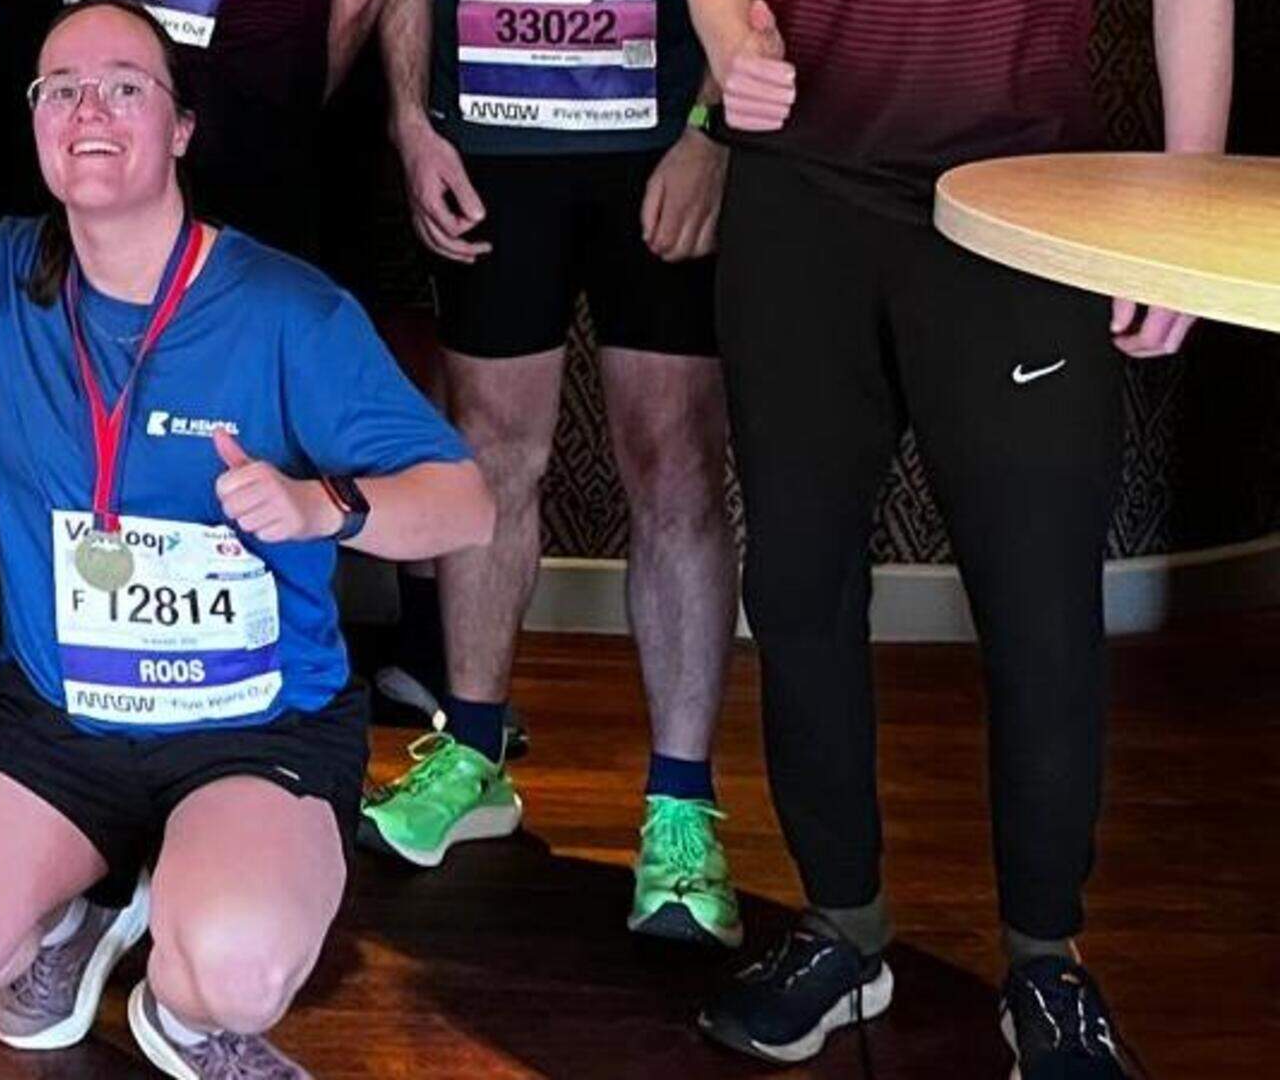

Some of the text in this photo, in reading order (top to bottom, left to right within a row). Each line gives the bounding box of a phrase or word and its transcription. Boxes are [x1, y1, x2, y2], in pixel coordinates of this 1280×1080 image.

[495, 8, 617, 44] 33022
[72, 583, 236, 627] F 12814
[140, 659, 206, 683] ROOS
